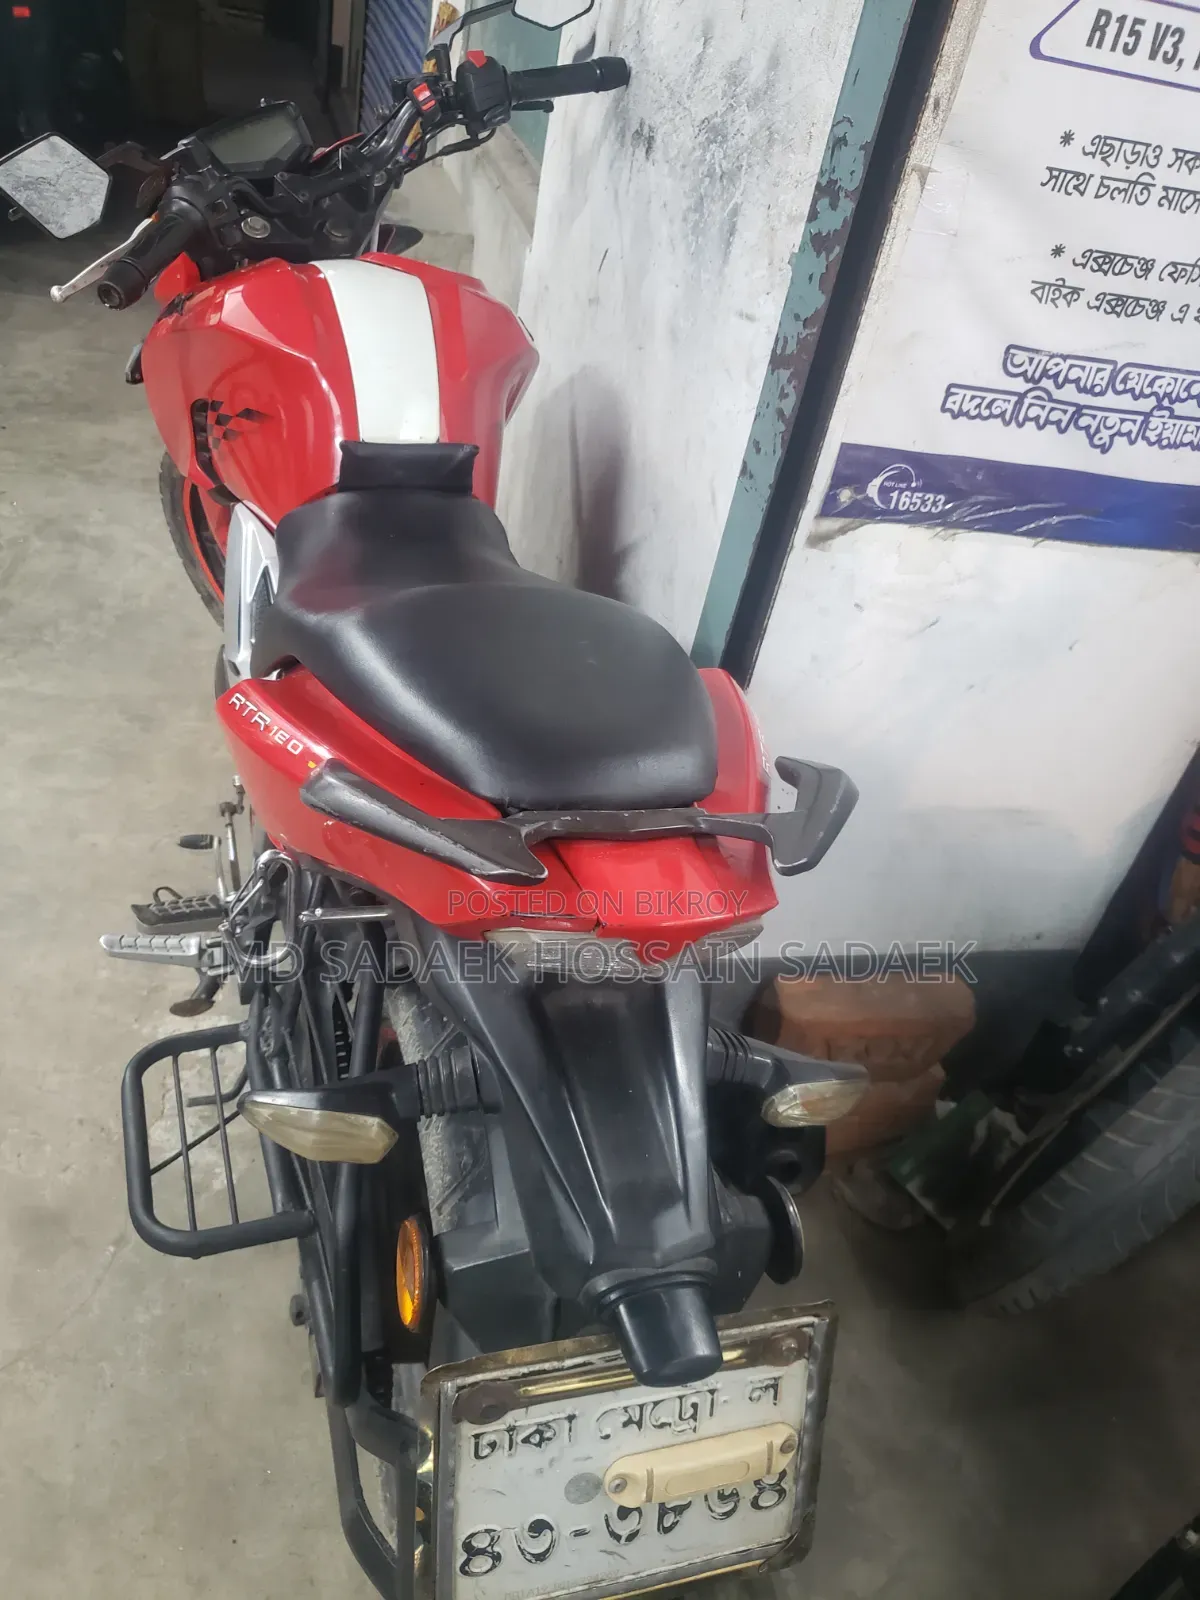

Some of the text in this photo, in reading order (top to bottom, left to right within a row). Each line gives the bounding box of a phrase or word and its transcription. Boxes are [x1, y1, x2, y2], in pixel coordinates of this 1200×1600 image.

[1085, 8, 1147, 56] R15
[1148, 22, 1185, 72] V3,
[1082, 134, 1163, 170] এছাড়াও
[1040, 166, 1094, 197] সাথে
[1094, 172, 1156, 206] চলতি
[1072, 248, 1156, 280] এক্সচেঞ্জ
[1030, 277, 1085, 309] বাইক
[1087, 292, 1167, 321] এক্সচেঞ্জ
[1171, 303, 1190, 324] এ
[1003, 344, 1117, 397] আপনার
[940, 383, 1022, 427] বদলে
[1014, 386, 1081, 434] নিন
[1073, 404, 1146, 454] নতুন
[889, 490, 945, 513] 16533
[229, 693, 271, 731] RTR
[469, 1411, 578, 1461] ঢাকা
[748, 1372, 784, 1406] ল
